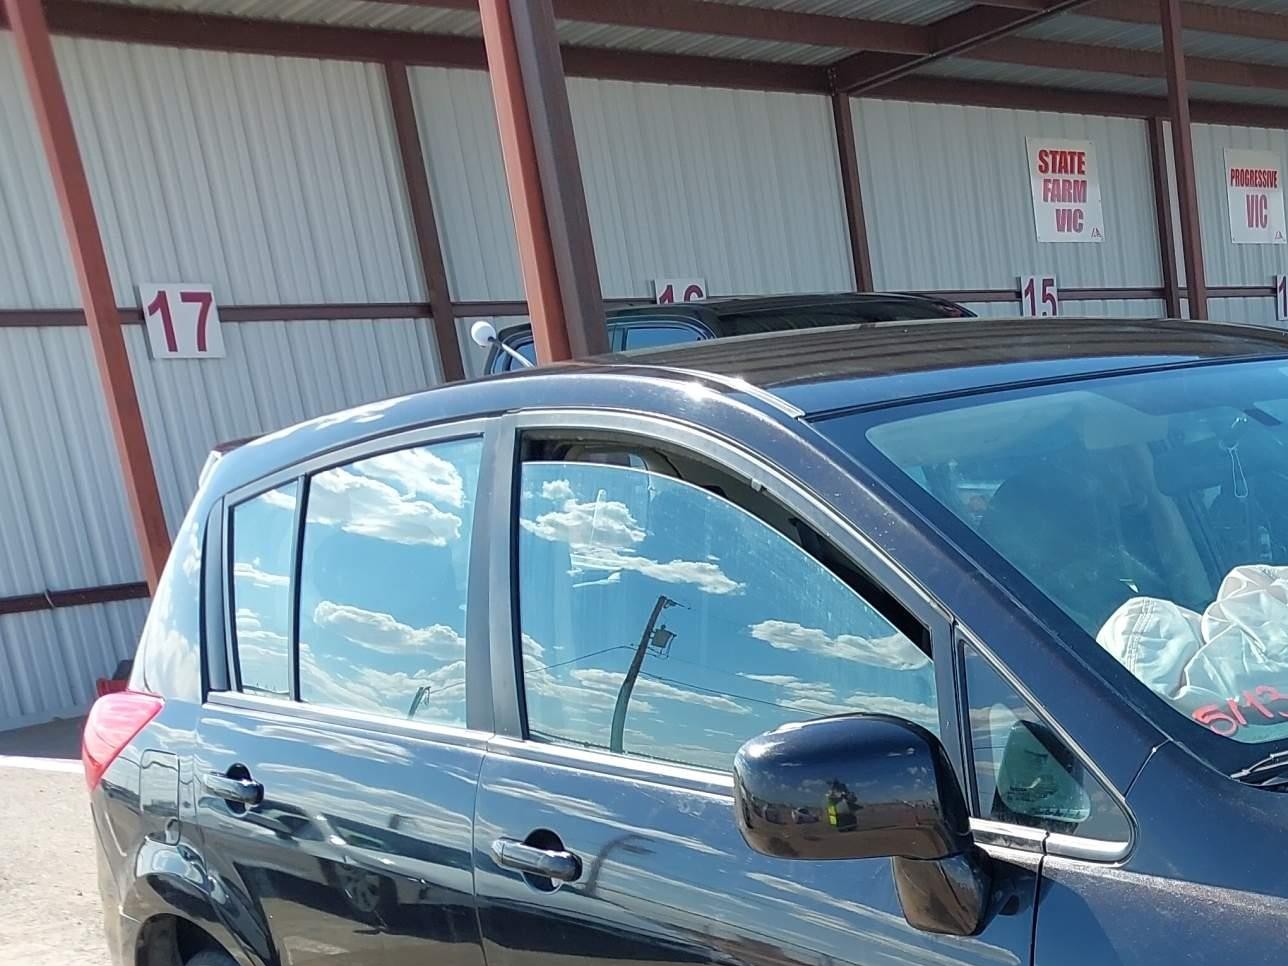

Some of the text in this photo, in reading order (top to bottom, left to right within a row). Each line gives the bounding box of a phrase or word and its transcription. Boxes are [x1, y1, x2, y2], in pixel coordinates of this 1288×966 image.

[1038, 149, 1086, 175] STATE
[1043, 178, 1088, 203] FARM
[1230, 168, 1278, 188] PROGRESSIVE
[1056, 208, 1084, 233] VIC
[1246, 194, 1268, 229] VIC
[1024, 278, 1057, 316] 15
[147, 290, 213, 352] 17
